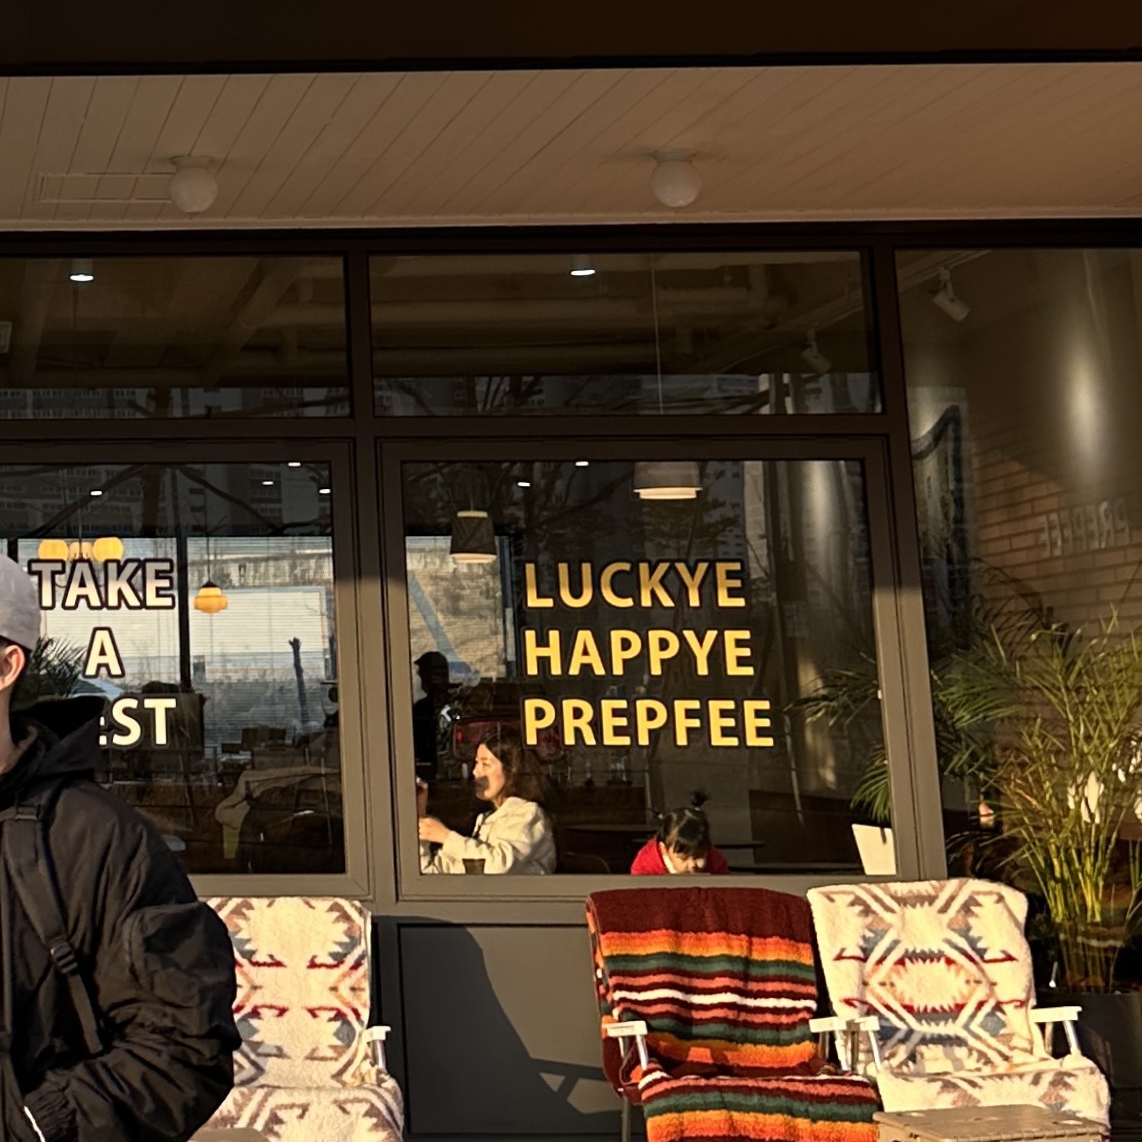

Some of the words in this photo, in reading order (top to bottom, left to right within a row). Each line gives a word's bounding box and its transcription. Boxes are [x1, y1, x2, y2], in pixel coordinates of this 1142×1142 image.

[30, 559, 175, 609] TAKE
[525, 561, 746, 608] LUCKYE
[84, 629, 125, 678] A
[524, 629, 755, 676] HAPPYE
[524, 699, 775, 747] PREPFEE
